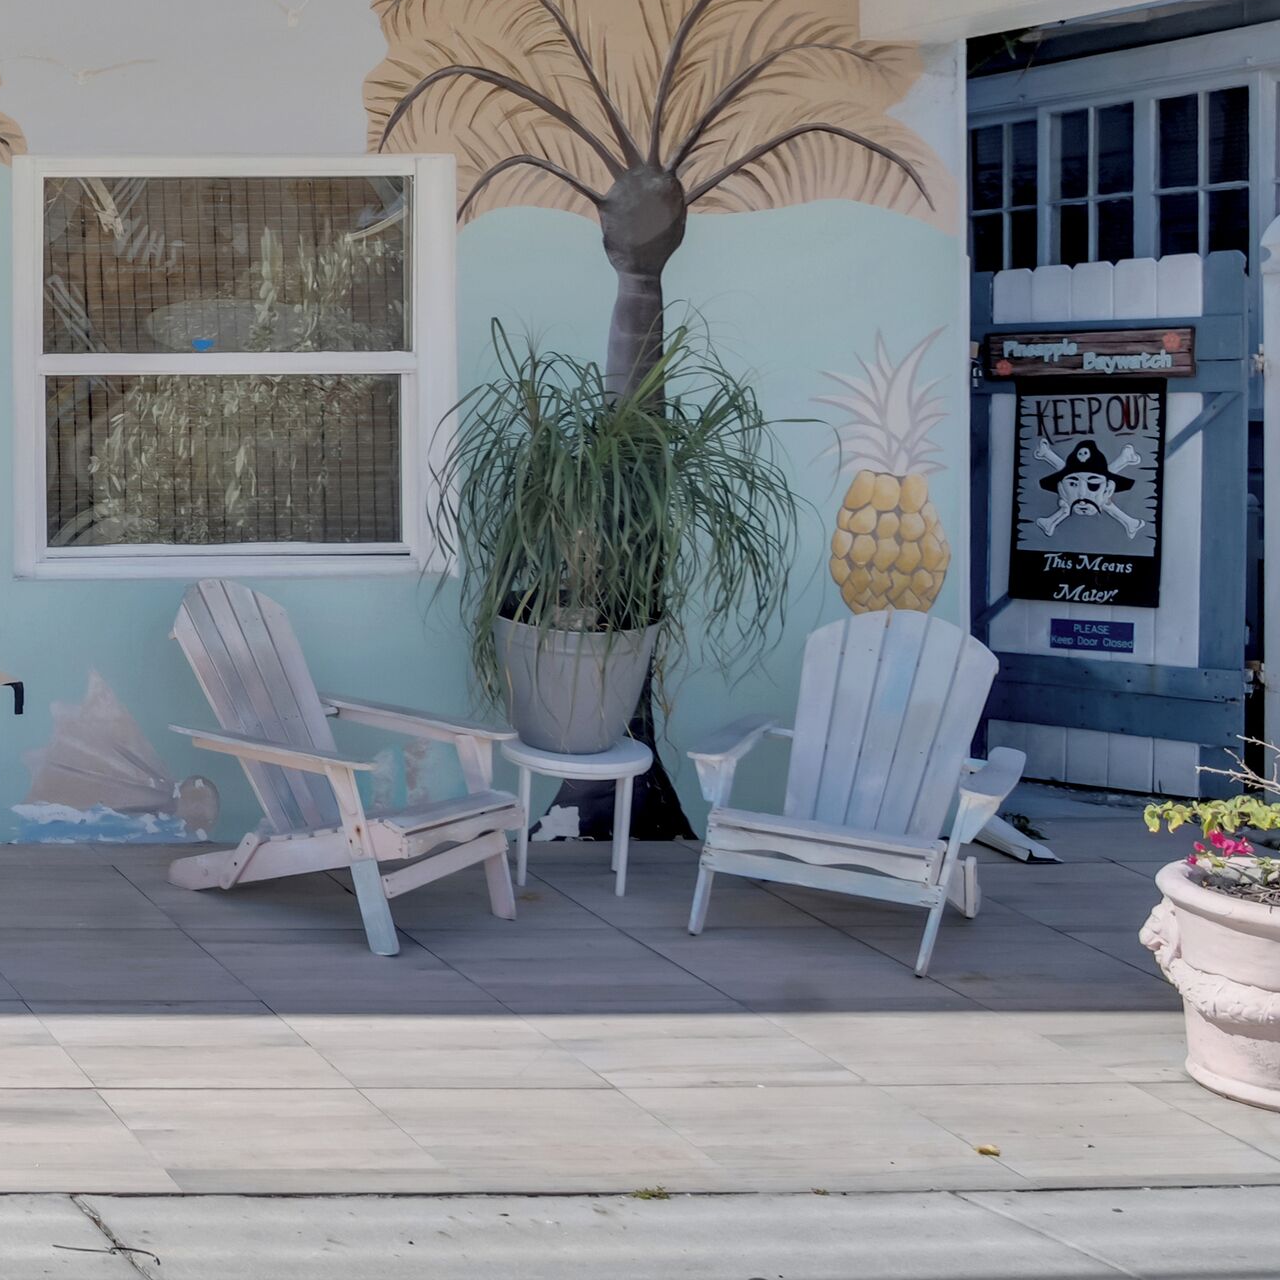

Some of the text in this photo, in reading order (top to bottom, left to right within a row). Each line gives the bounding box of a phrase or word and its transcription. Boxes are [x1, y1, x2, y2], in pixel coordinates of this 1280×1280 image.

[1003, 338, 1078, 362] Pineapple
[1083, 349, 1173, 374] Baywatch
[1036, 394, 1151, 444] KEEP OUT
[1043, 552, 1133, 574] This Means
[1053, 584, 1119, 603] Matey!
[1073, 624, 1110, 635] PLEASE
[1051, 635, 1134, 648] Keep Door Closed
